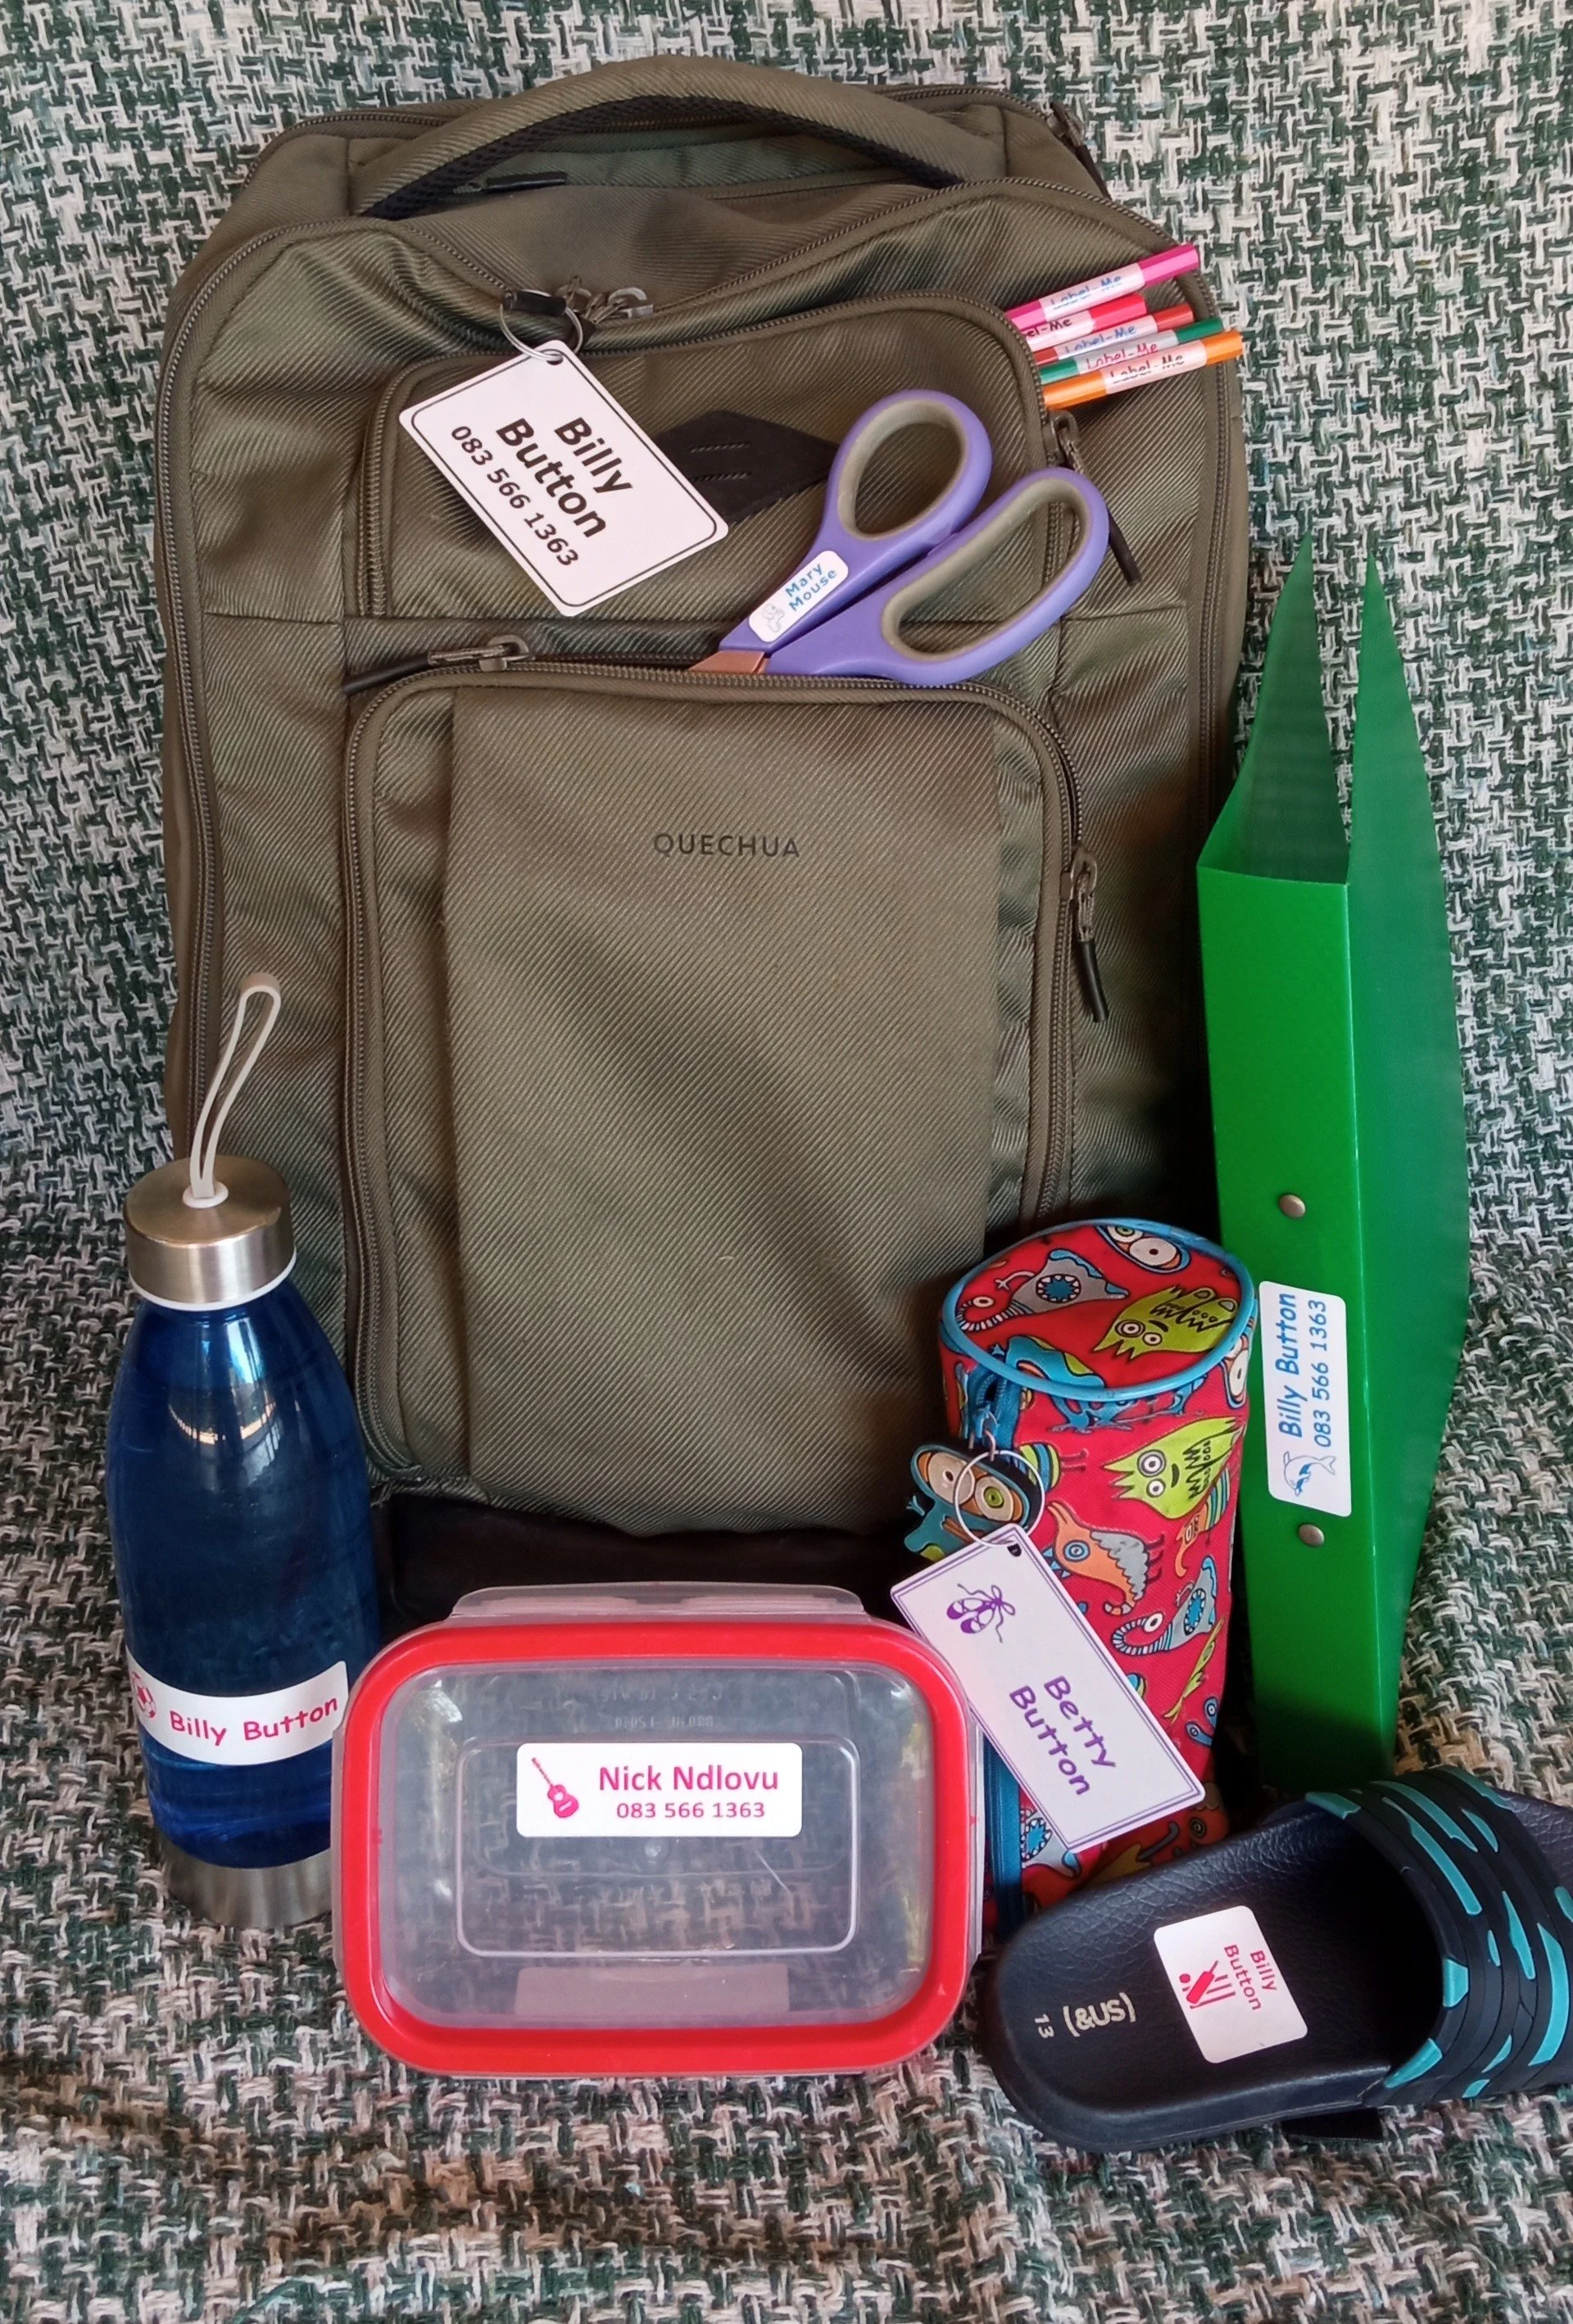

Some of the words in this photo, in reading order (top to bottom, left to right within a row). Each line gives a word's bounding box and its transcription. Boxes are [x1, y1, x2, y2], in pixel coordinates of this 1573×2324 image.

[496, 419, 605, 537] Button
[555, 418, 632, 493] Billy
[451, 427, 492, 465] 083
[487, 469, 530, 509] 566
[524, 513, 578, 565] 1363
[786, 564, 822, 597] Mary
[789, 571, 835, 610] Mouse
[654, 833, 800, 858] QUECHUA
[1275, 1294, 1299, 1375] Button
[1308, 1299, 1328, 1352] 1363
[1312, 1363, 1329, 1400] 566
[1277, 1385, 1307, 1437] Billy
[1313, 1410, 1330, 1447] 083
[170, 1710, 226, 1746] Billy
[244, 1698, 337, 1740] Button
[1009, 1685, 1090, 1795] Button
[1044, 1676, 1116, 1767] Betty
[600, 1765, 661, 1791] Nick
[673, 1765, 777, 1790] Ndlovu
[617, 1803, 655, 1818] 083
[665, 1802, 704, 1818] 566
[714, 1802, 764, 1818] 1363
[1224, 1945, 1261, 2009] Button
[1250, 1950, 1276, 1990] Billy
[1035, 2014, 1054, 2039] 13
